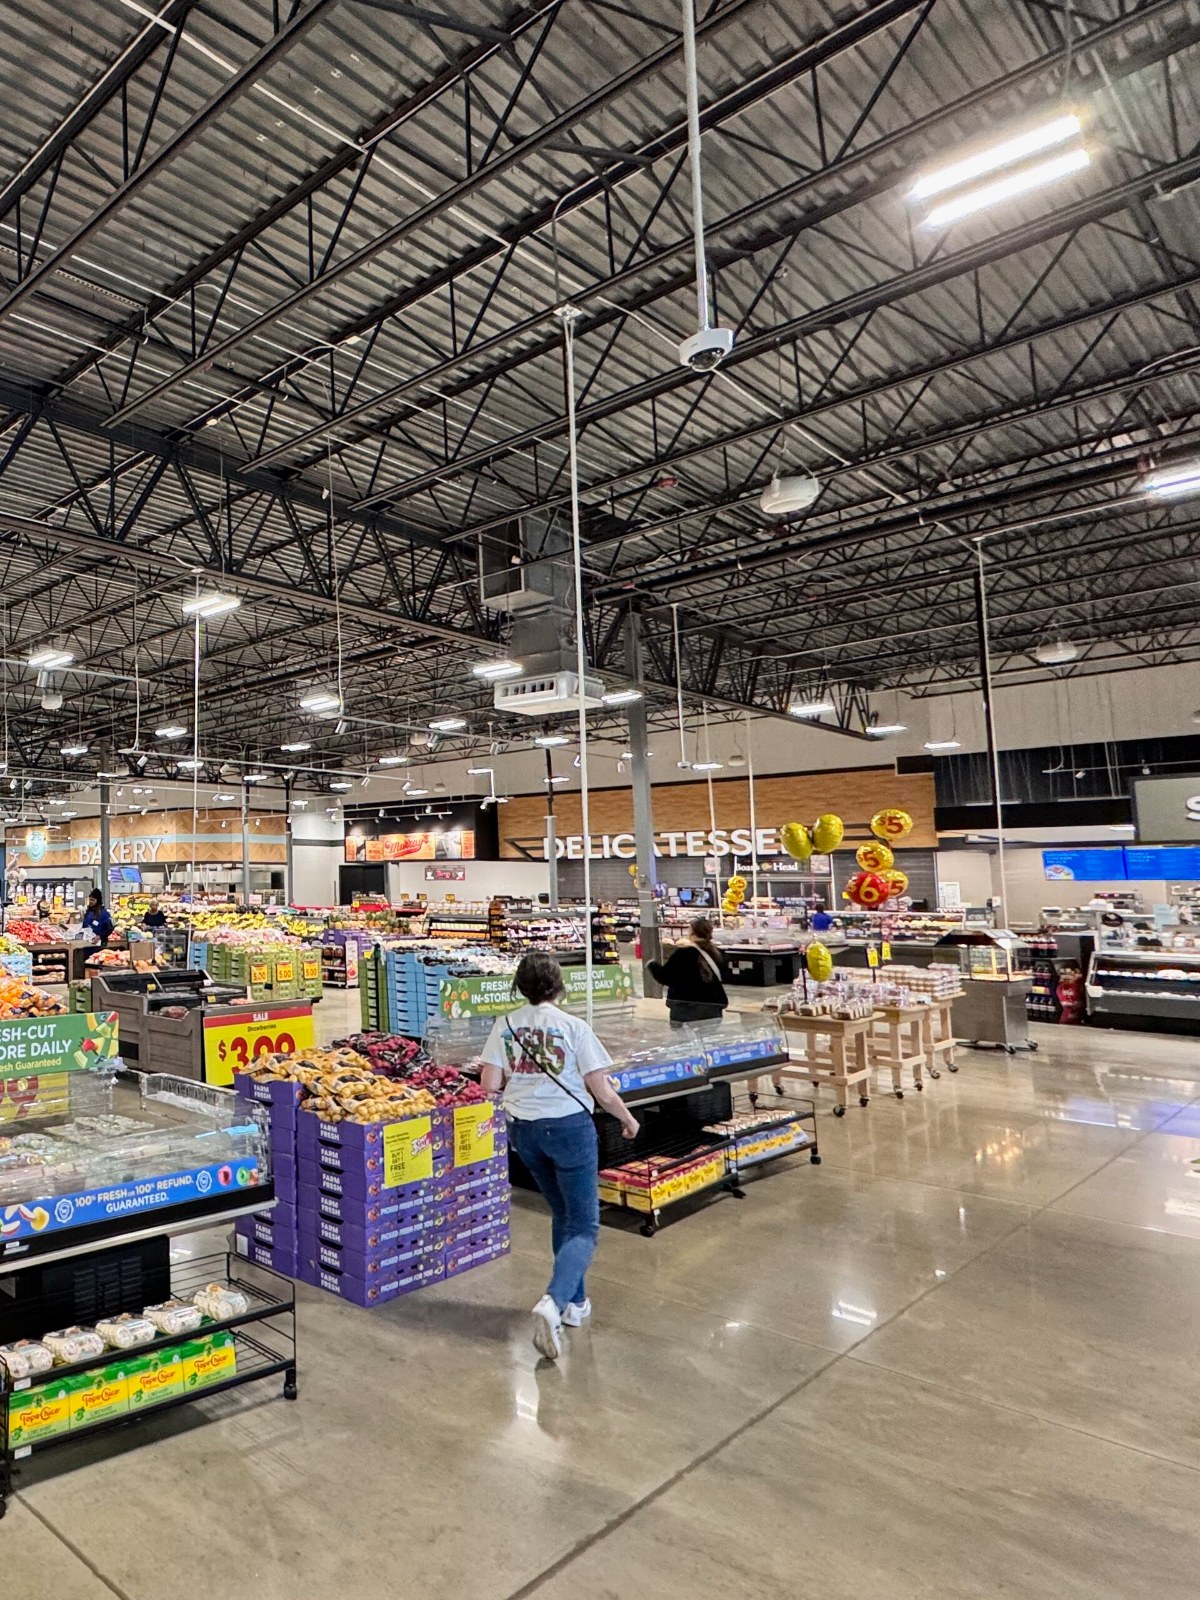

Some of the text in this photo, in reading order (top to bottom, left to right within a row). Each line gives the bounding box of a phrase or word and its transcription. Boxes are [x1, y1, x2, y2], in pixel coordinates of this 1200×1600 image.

[543, 828, 790, 860] DELICTESSE
[79, 838, 163, 865] BAKERY
[736, 862, 798, 872] Boars Head
[278, 970, 291, 979] 5.00
[305, 968, 317, 976] 5.00
[253, 1012, 269, 1022] SALE
[30, 1039, 72, 1057] DAILY
[15, 1057, 61, 1072] Guaranteed
[320, 1123, 338, 1133] FARM
[320, 1130, 339, 1141] FRESH
[321, 1149, 339, 1159] FARM
[321, 1156, 340, 1167] FRESH
[322, 1173, 340, 1184] FARM
[97, 1188, 127, 1203] FRESH
[157, 1175, 194, 1190] REFUND.
[323, 1181, 342, 1193] FRESH
[105, 1192, 169, 1213] GUARANTEED.
[321, 1197, 339, 1208] FARM
[321, 1205, 341, 1217] FRESH
[321, 1222, 339, 1233] FARM
[321, 1230, 340, 1242] FRESH
[320, 1247, 338, 1258] FARM
[321, 1255, 340, 1267] FRESH
[320, 1272, 338, 1284] FARM
[321, 1280, 340, 1293] FRESH
